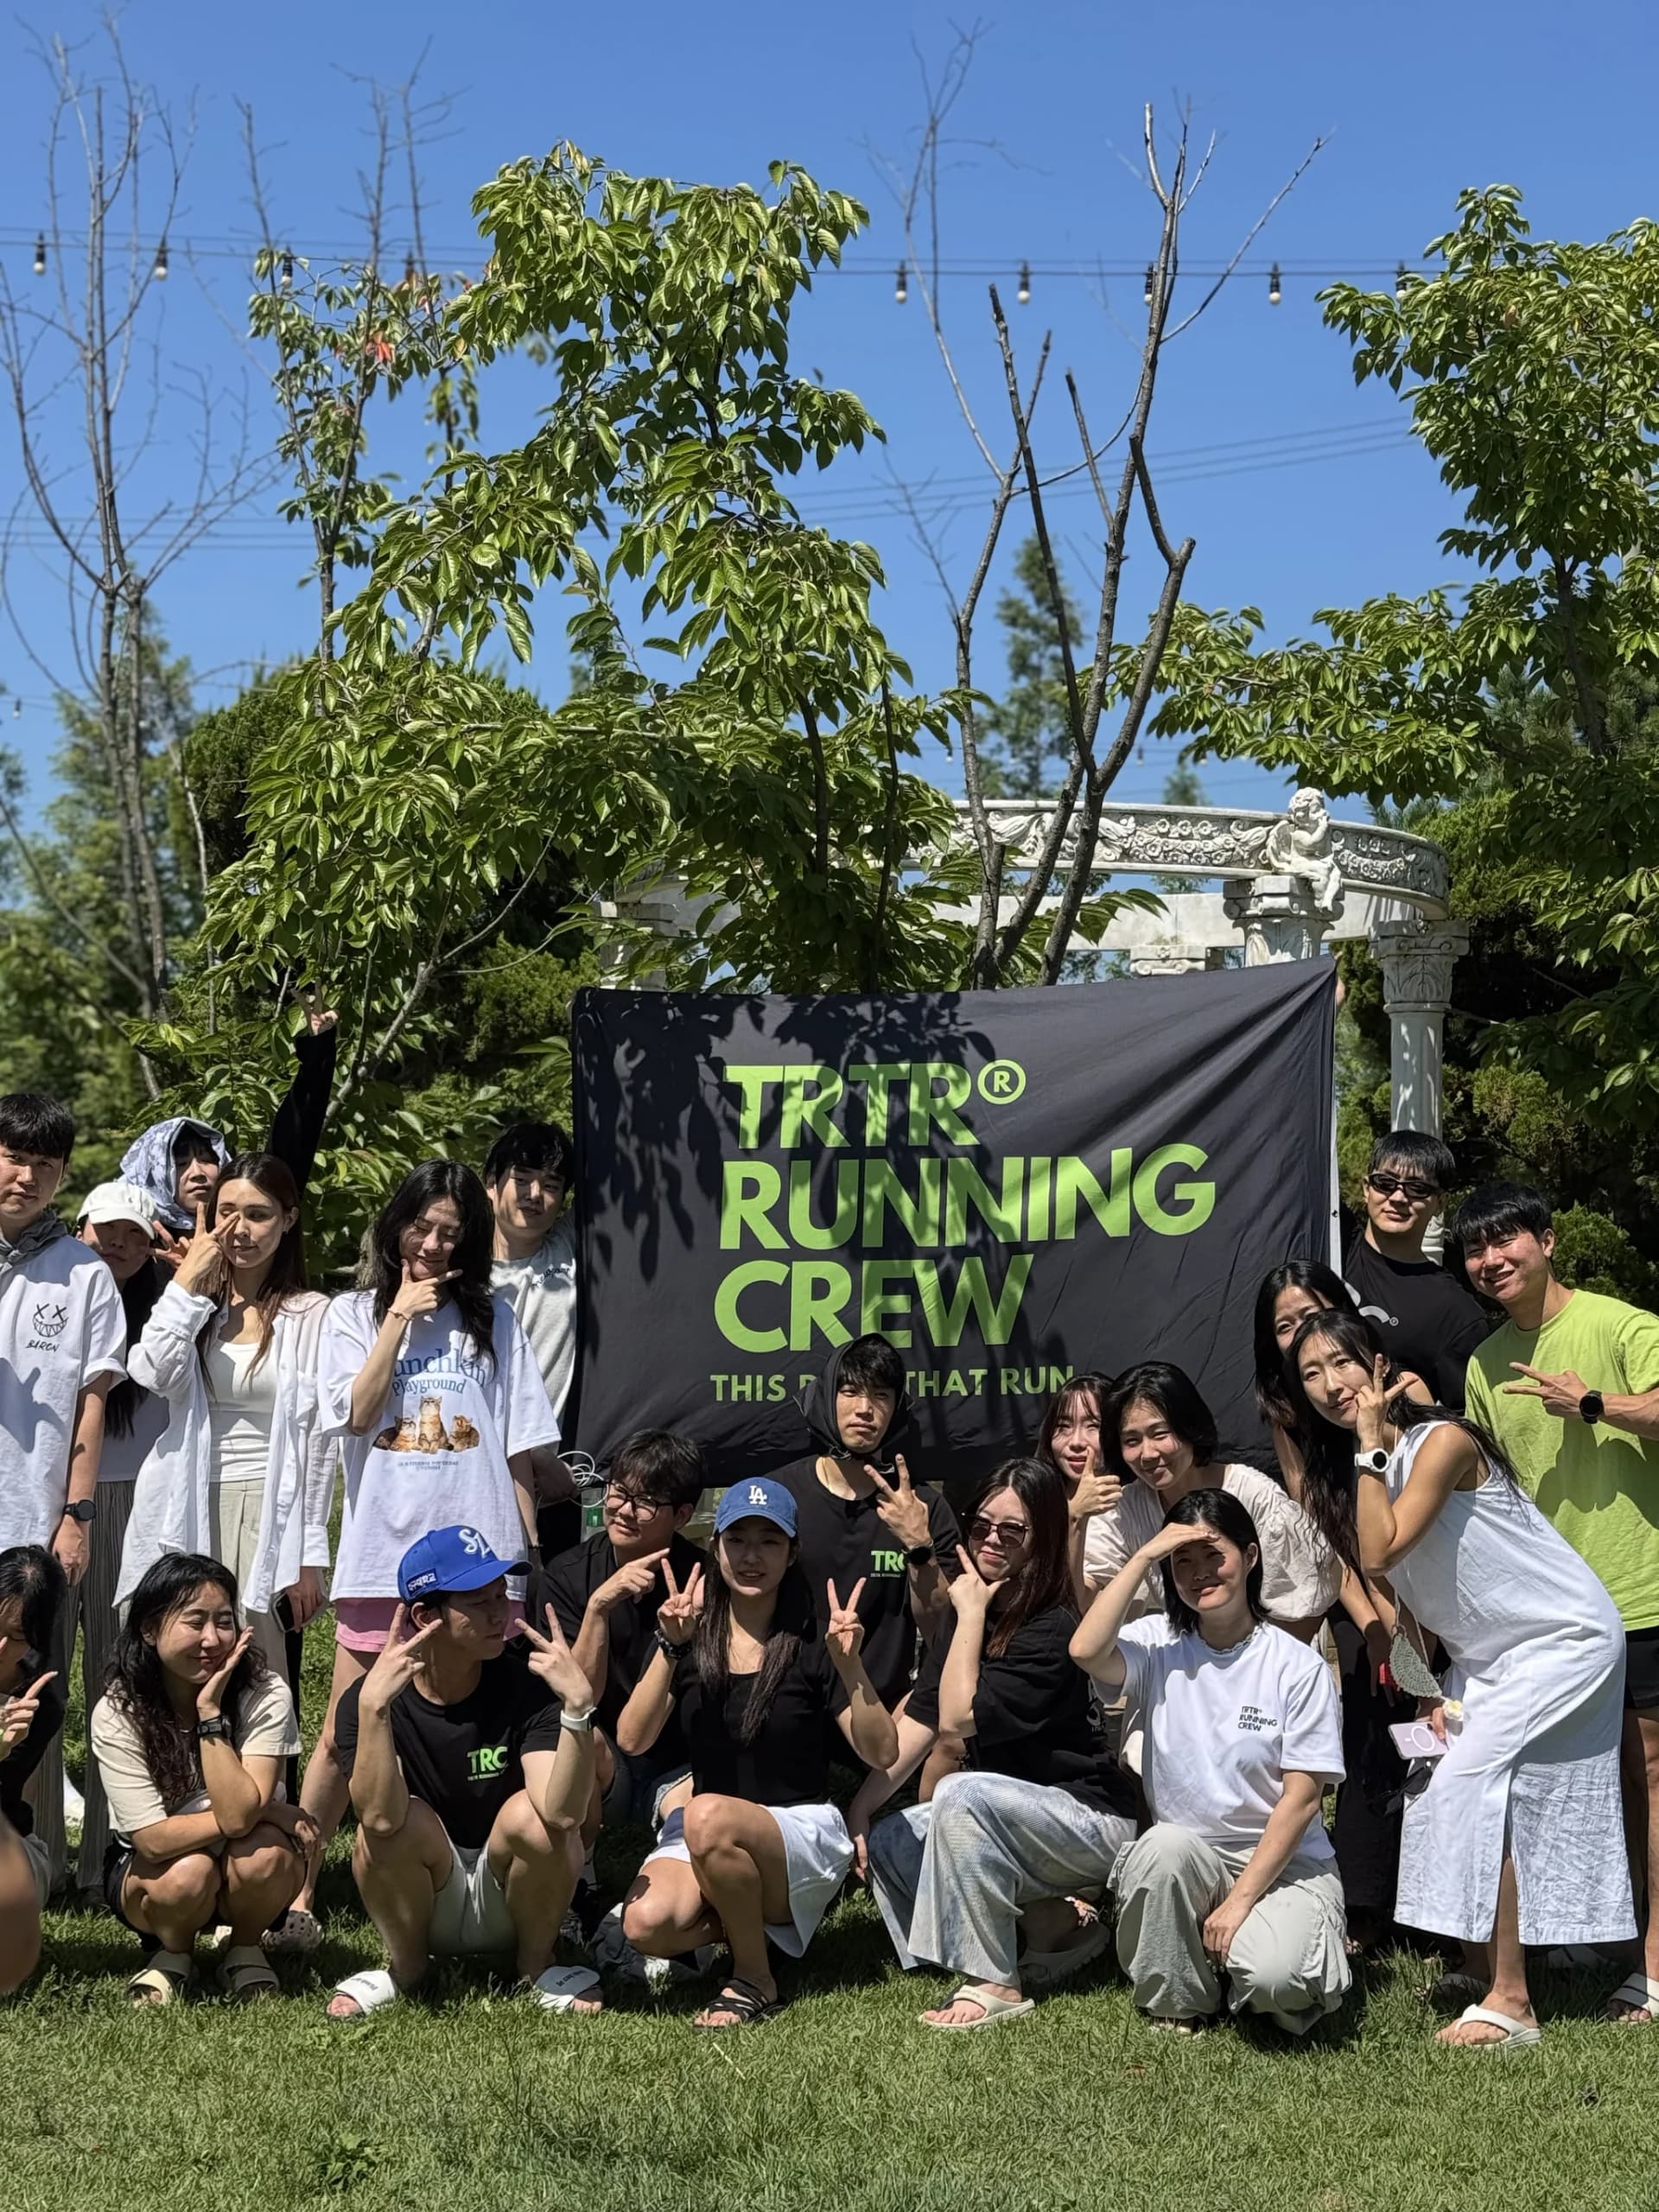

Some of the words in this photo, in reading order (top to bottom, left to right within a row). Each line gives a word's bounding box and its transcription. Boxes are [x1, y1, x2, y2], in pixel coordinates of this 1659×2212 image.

[720, 1141, 1217, 1250] RUNNING
[714, 1253, 1034, 1354] CREW
[394, 1348, 486, 1389] unchkin
[710, 1373, 786, 1402] THIS
[906, 1369, 987, 1398] THAT
[1001, 1366, 1074, 1395] RUN
[392, 1378, 467, 1396] Playground
[748, 1485, 767, 1504] LA
[467, 1746, 508, 1773] TRC
